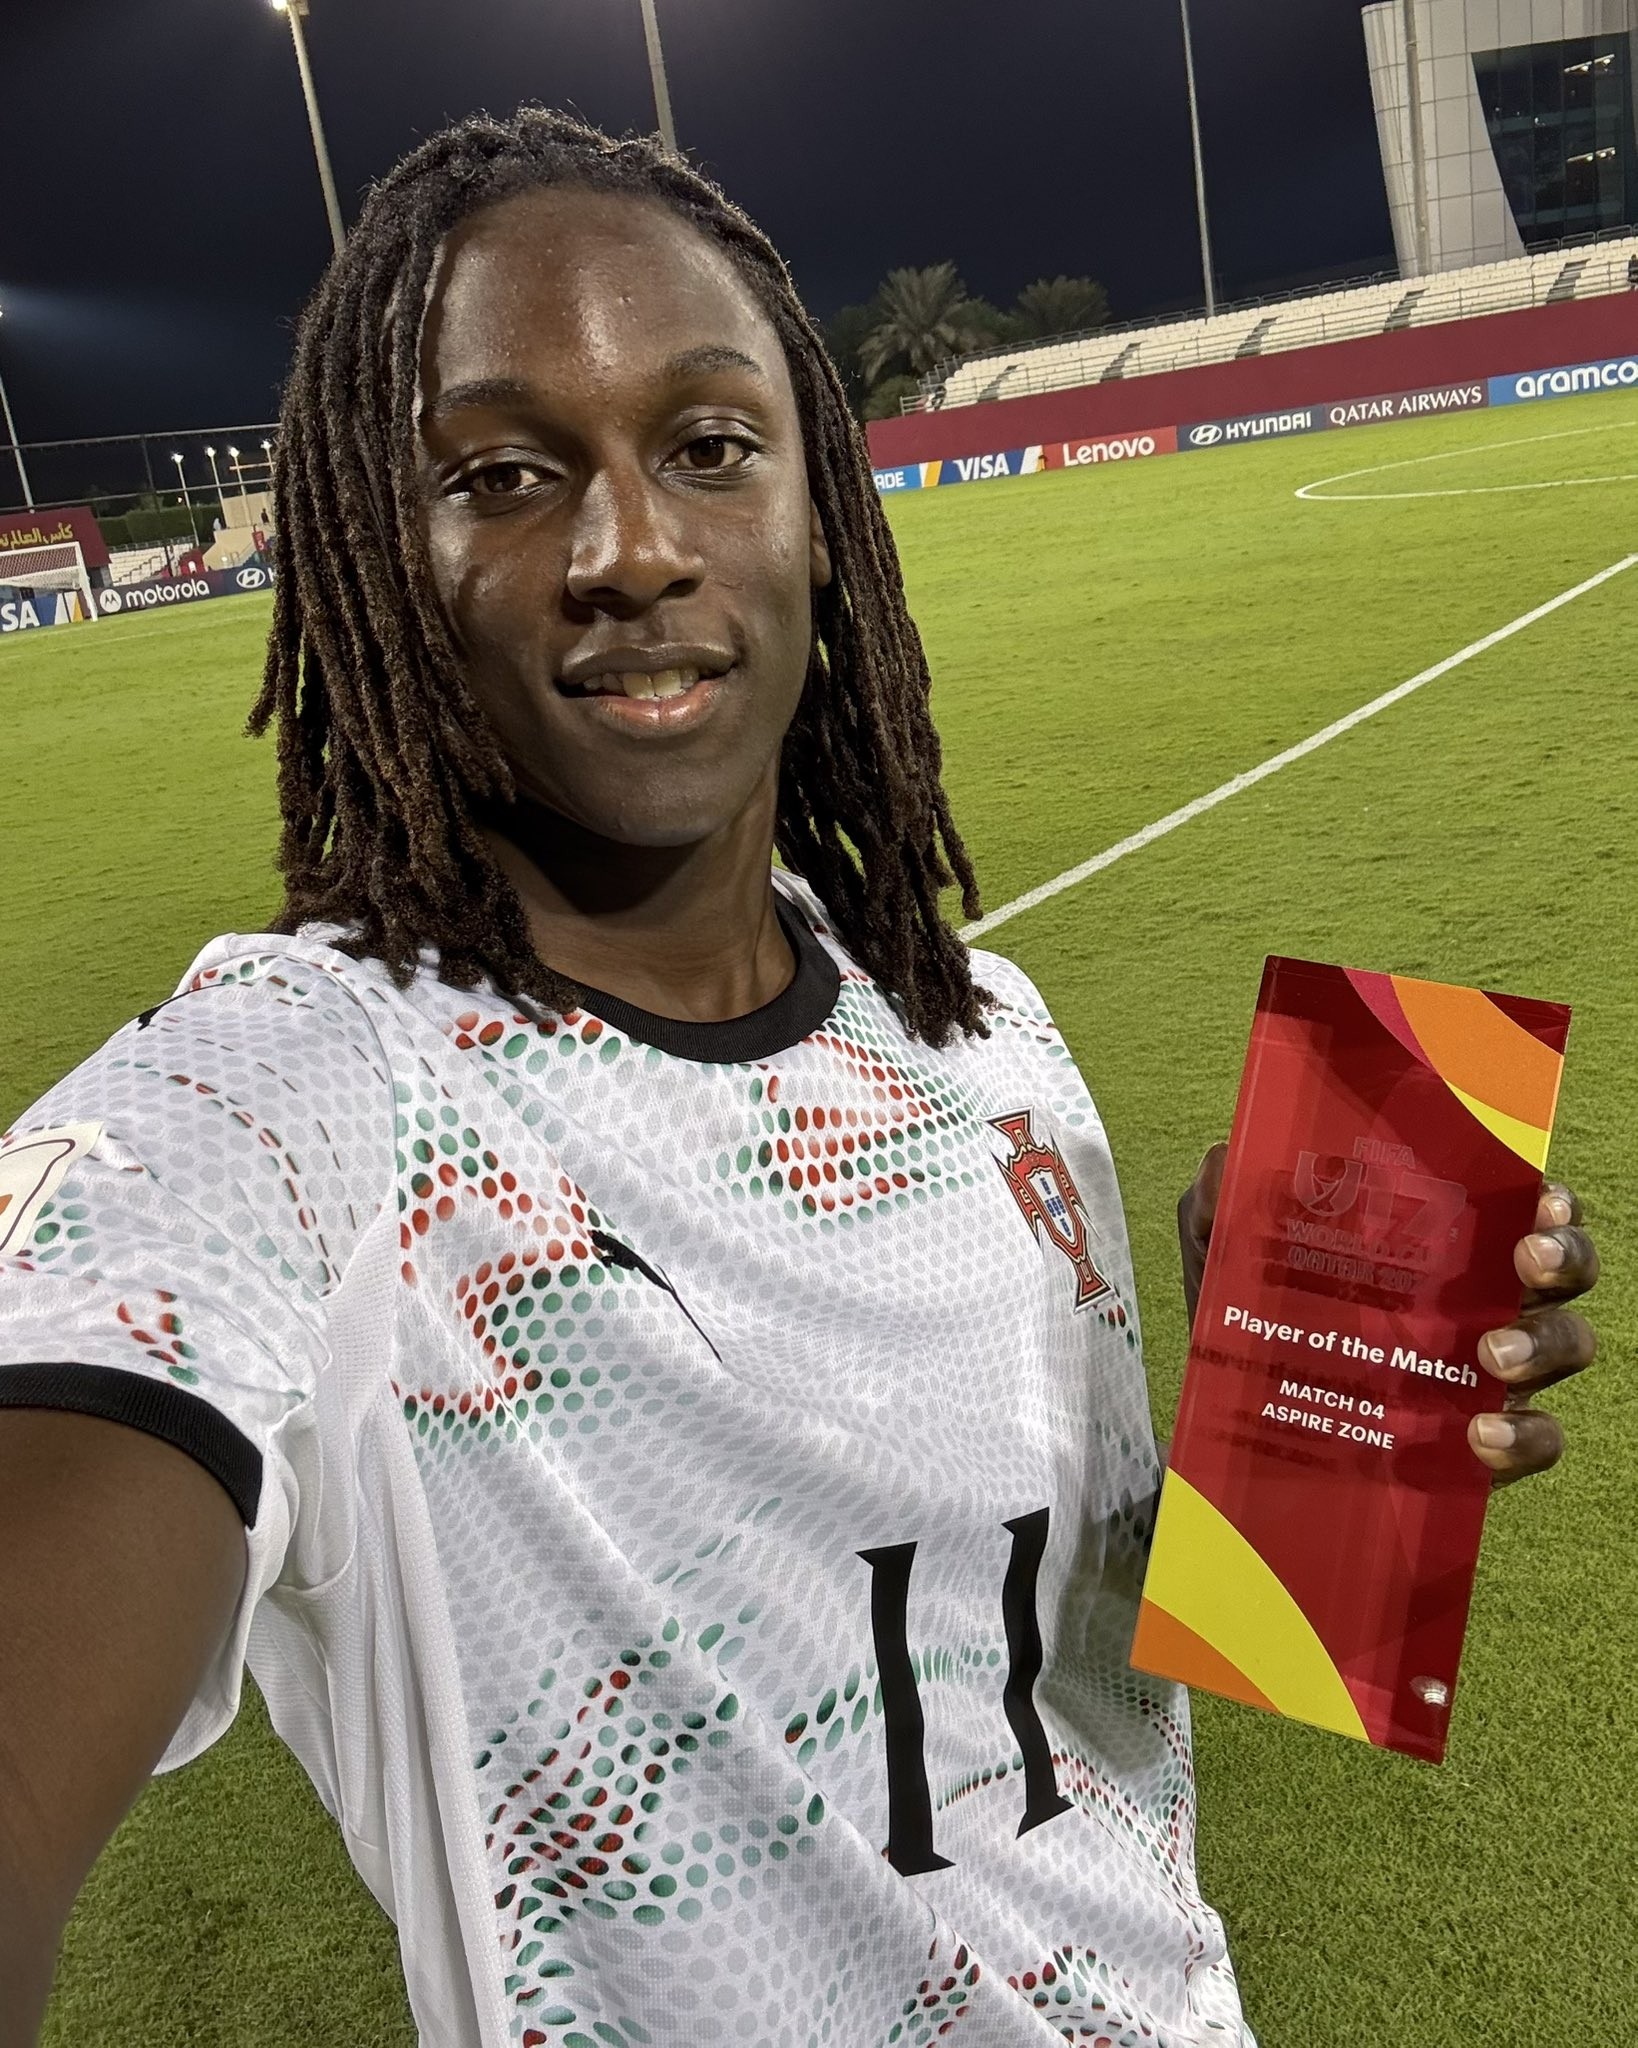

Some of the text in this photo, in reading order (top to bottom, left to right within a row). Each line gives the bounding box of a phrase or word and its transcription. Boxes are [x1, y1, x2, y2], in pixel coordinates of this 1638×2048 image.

[1515, 361, 1638, 398] aramco
[1329, 386, 1482, 426] QATAR AIRWAYS
[1225, 411, 1312, 440] HYUNDAI
[952, 453, 1010, 481] VISA
[1063, 436, 1156, 467] Lenovo
[873, 471, 906, 491] ADE
[126, 579, 210, 609] motorola
[0, 600, 41, 632] SA
[1352, 1136, 1417, 1169] FIFA
[1223, 1305, 1478, 1388] Player of the Match
[1279, 1379, 1386, 1420] MATCH 04
[1261, 1402, 1395, 1450] ASPIRE ZONE
[855, 1506, 1074, 1878] 11
